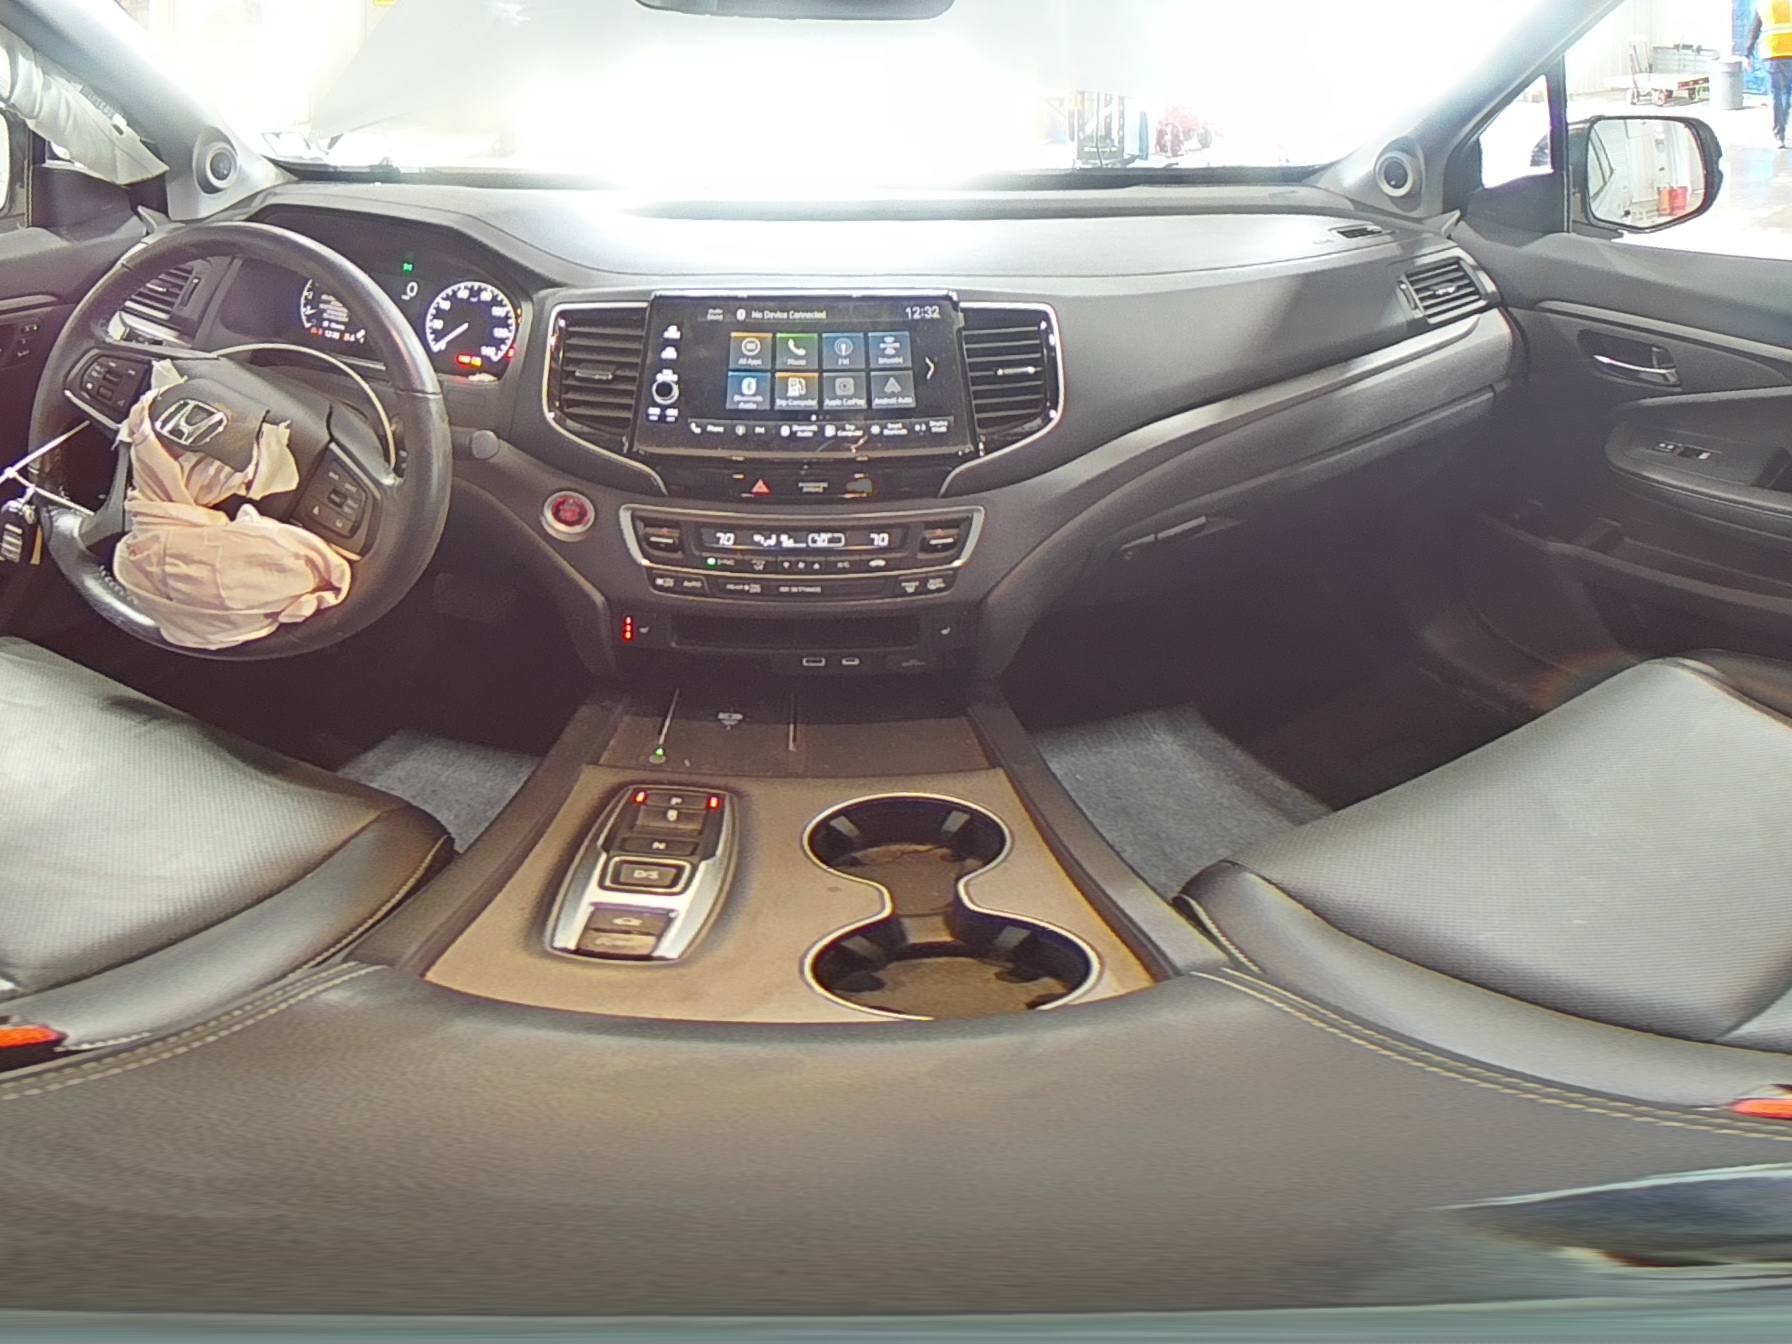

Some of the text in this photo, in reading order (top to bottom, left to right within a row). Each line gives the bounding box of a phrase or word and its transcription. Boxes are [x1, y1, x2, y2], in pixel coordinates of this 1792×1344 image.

[407, 282, 418, 297] 0
[751, 309, 827, 319] No Device Connected
[905, 306, 941, 320] 12:32
[715, 532, 735, 545] 70
[869, 533, 889, 546] 70
[670, 796, 683, 805] P
[652, 842, 666, 850] N
[633, 869, 659, 879] D/S
